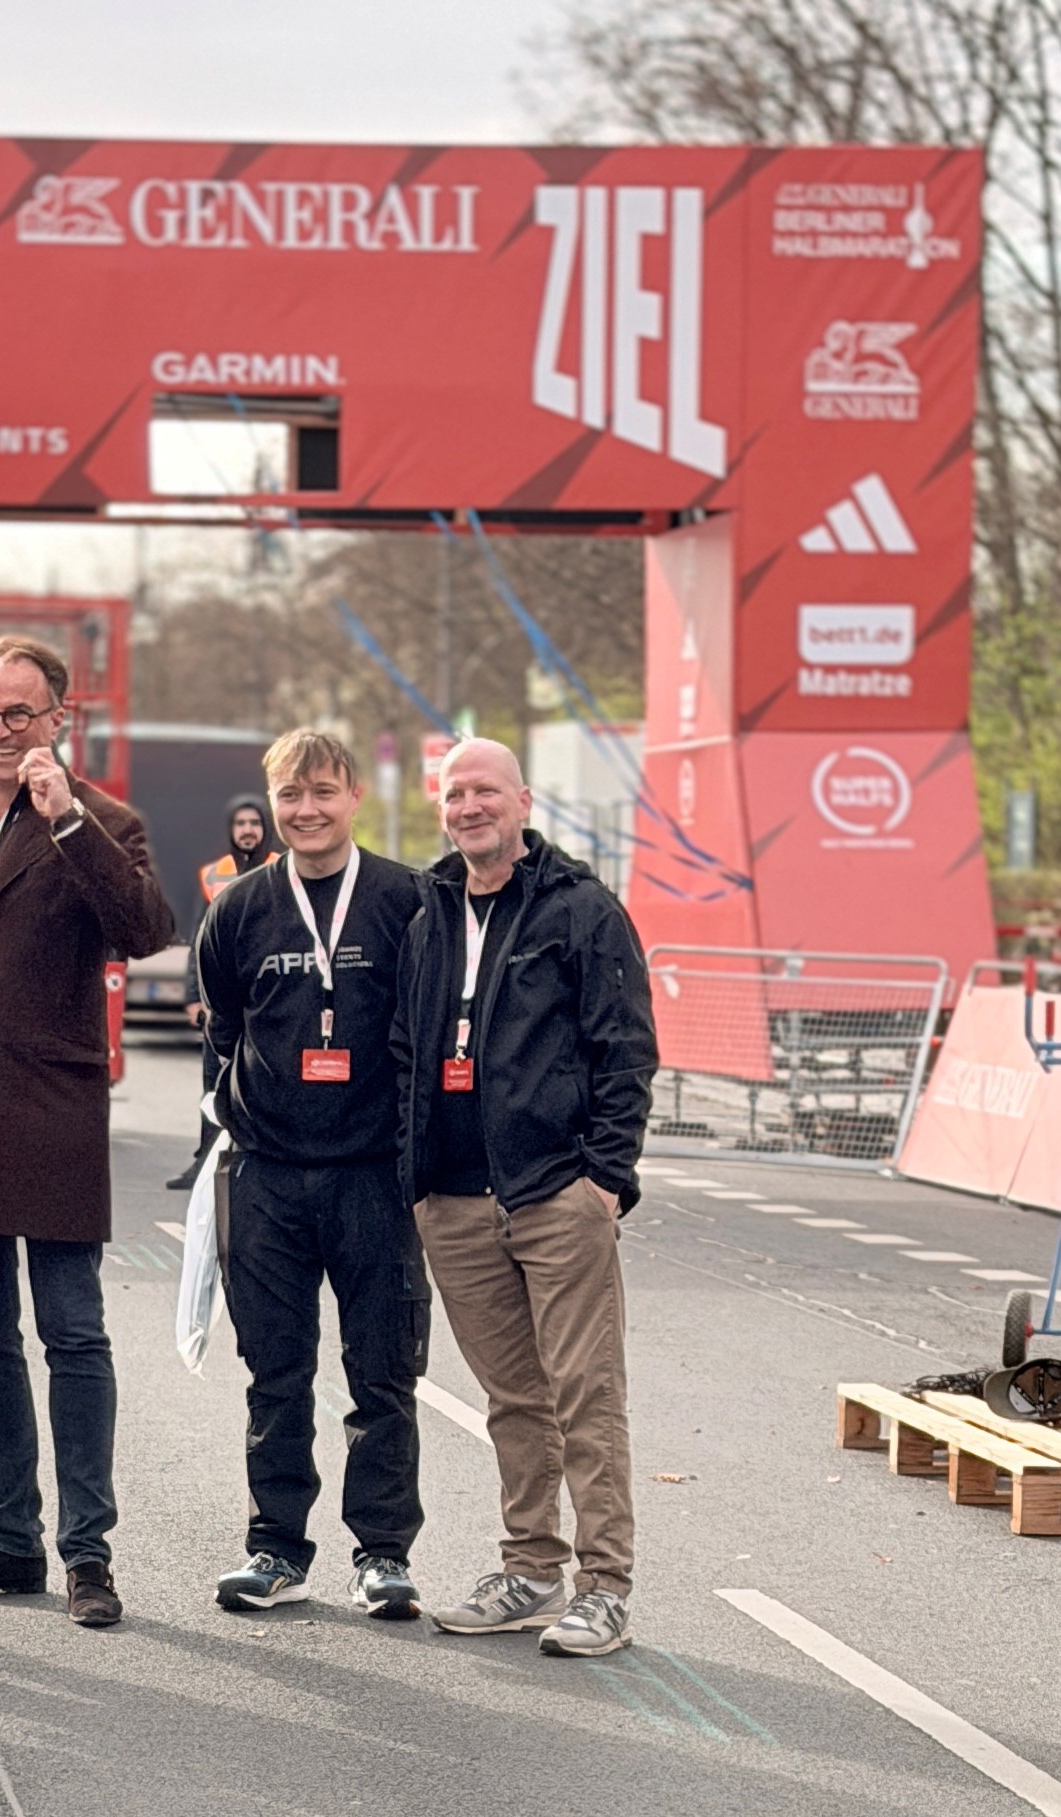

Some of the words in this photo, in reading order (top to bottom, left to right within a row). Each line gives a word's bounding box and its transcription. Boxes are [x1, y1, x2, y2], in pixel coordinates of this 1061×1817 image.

[806, 183, 909, 209] GENERALI
[128, 178, 481, 253] GENERALI
[773, 209, 886, 233] BERLINER
[532, 184, 728, 480] ZIEL
[803, 395, 919, 421] GENERALI
[808, 625, 902, 644] bett1.de
[799, 667, 912, 698] Matratze
